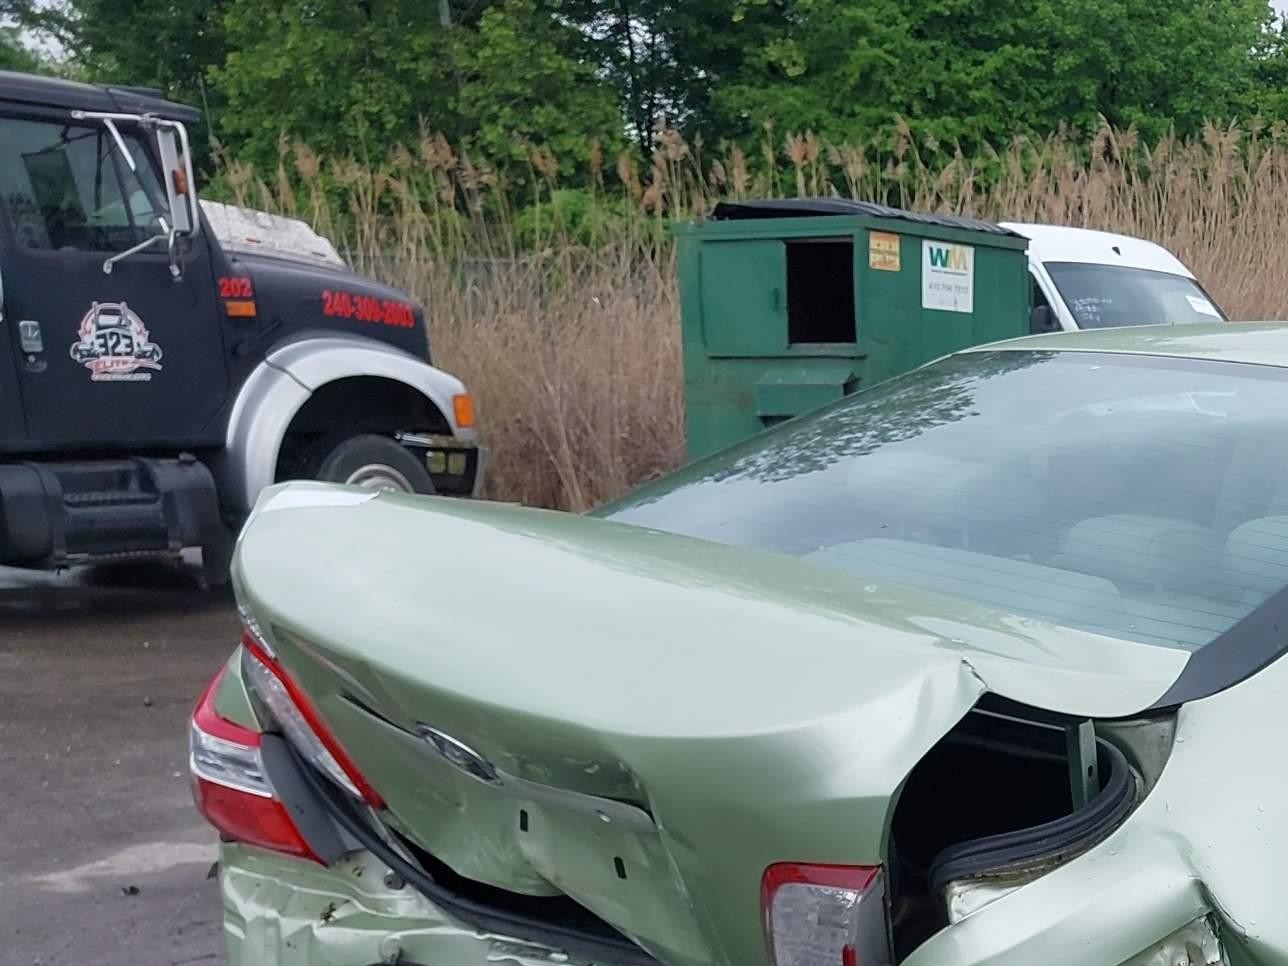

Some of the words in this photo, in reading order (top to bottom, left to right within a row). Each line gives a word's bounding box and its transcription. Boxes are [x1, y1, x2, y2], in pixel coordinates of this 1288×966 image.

[929, 246, 968, 271] WM
[219, 277, 253, 298] 202
[95, 333, 134, 357] 323
